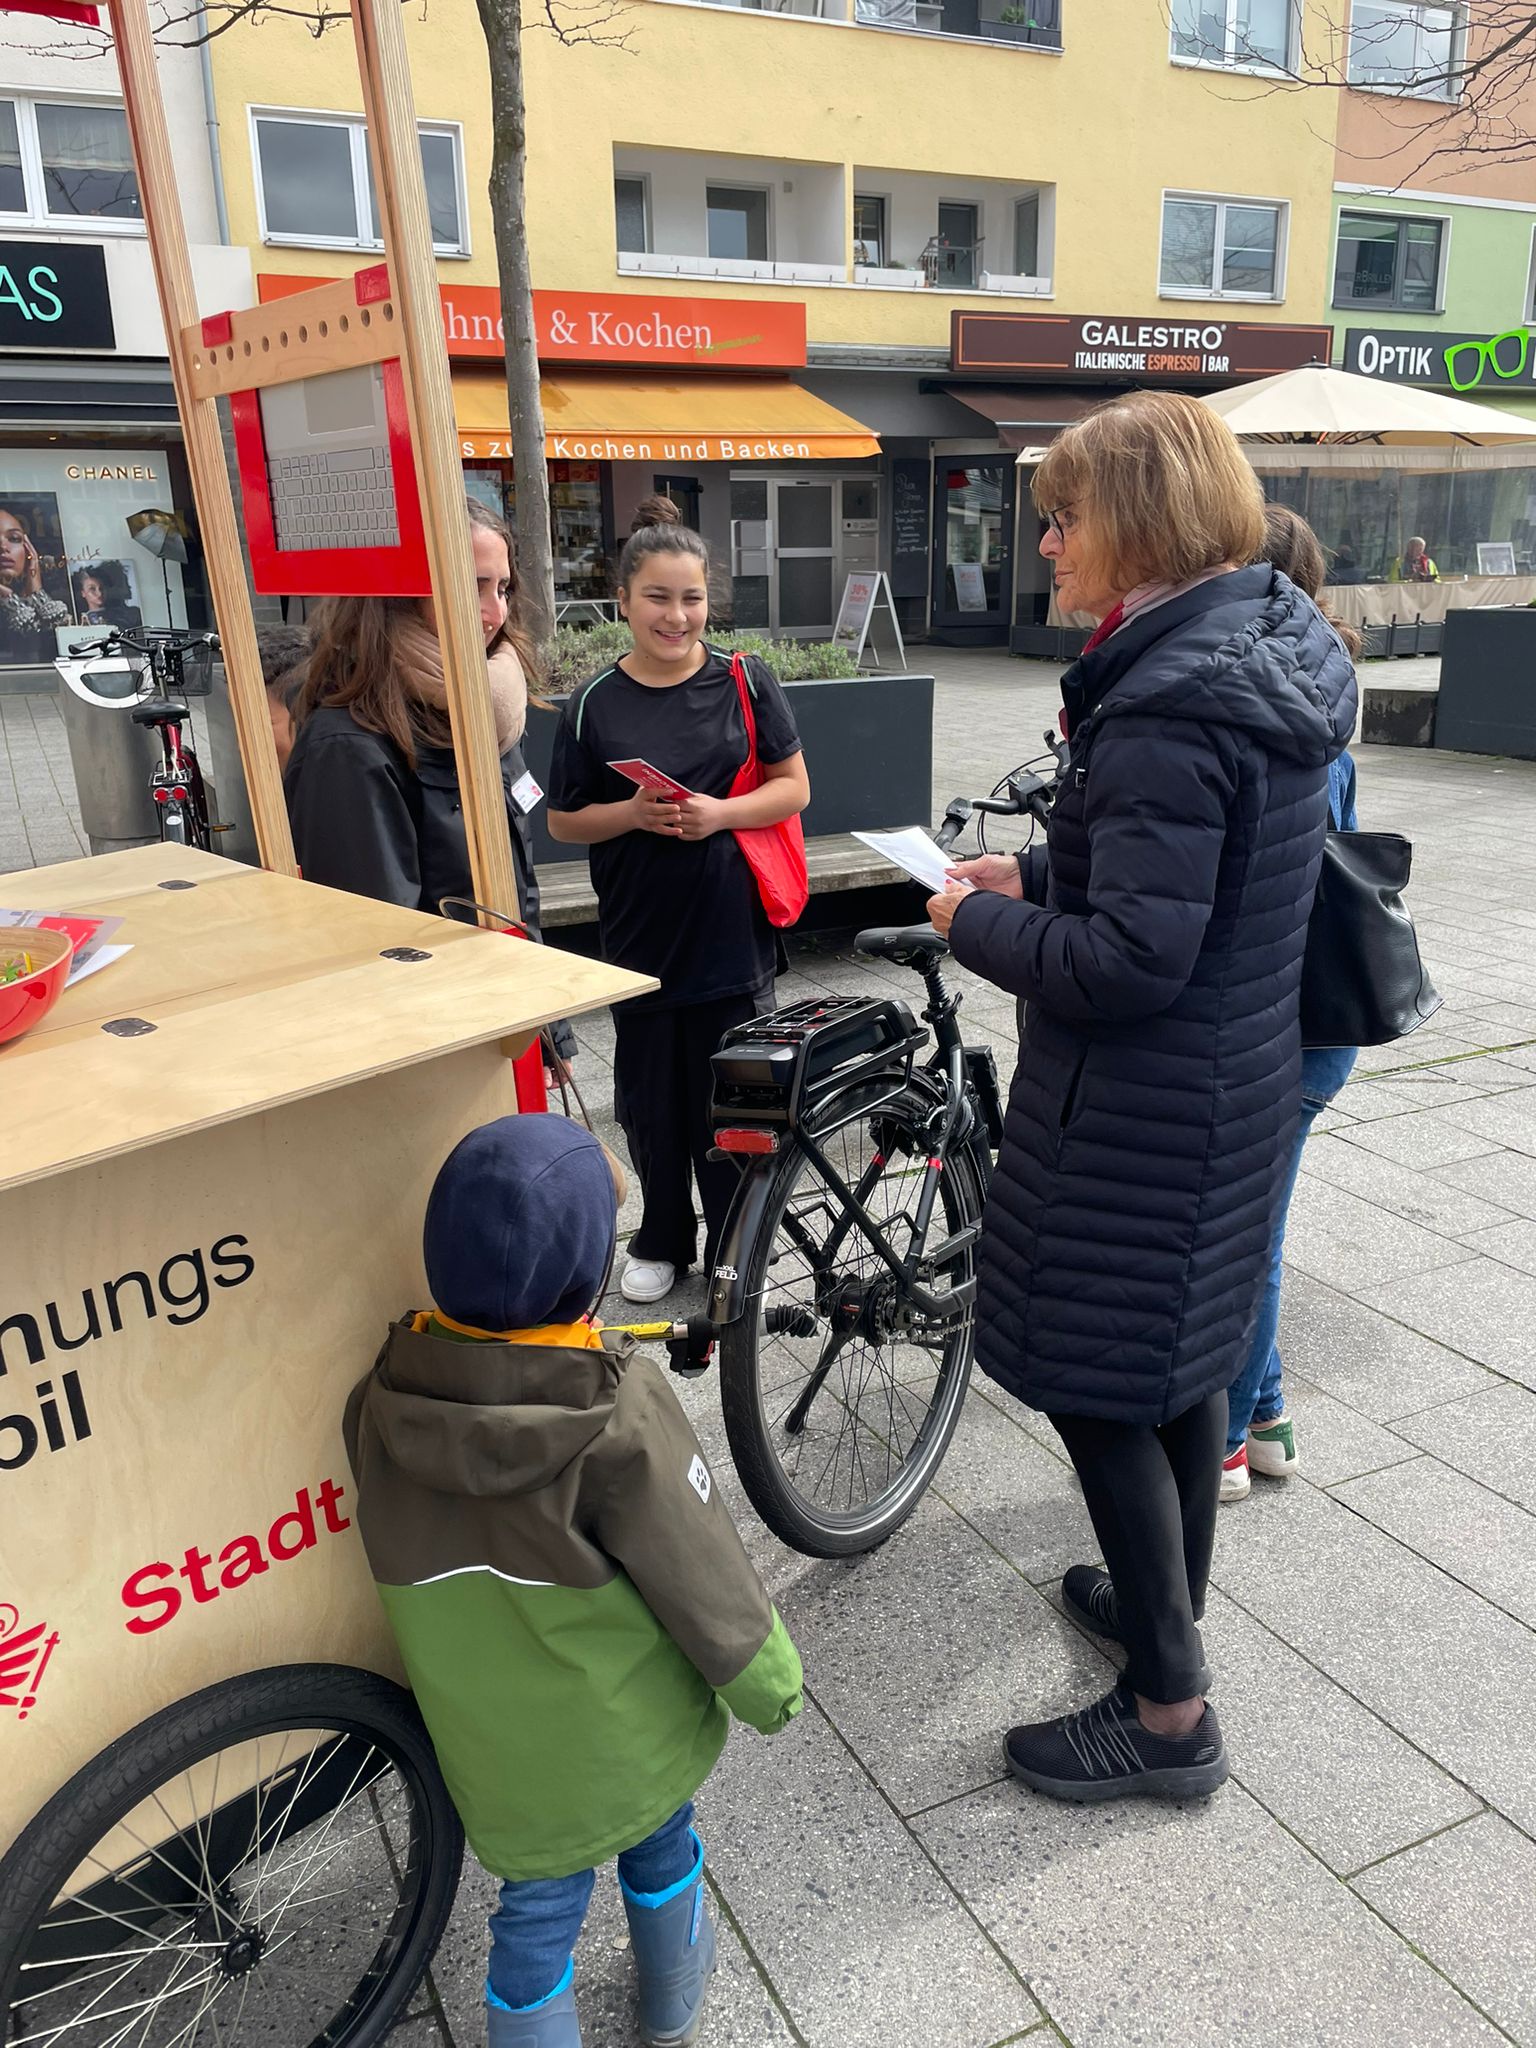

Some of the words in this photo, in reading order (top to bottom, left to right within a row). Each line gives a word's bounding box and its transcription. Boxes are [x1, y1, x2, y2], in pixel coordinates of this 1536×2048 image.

[550, 310, 579, 344] &
[588, 311, 712, 349] Kochen
[1082, 321, 1224, 350] GALESTRO
[1075, 352, 1146, 371] ITALIENISCHE
[1147, 354, 1200, 371] ESPRESSO
[1208, 355, 1230, 372] BAR
[1358, 335, 1433, 375] OPTIK
[554, 438, 652, 458] Kochen
[664, 440, 708, 459] und
[720, 440, 810, 459] Backen
[67, 465, 158, 480] CHANEL
[715, 1270, 738, 1280] FELD
[121, 1478, 351, 1635] Stadt
